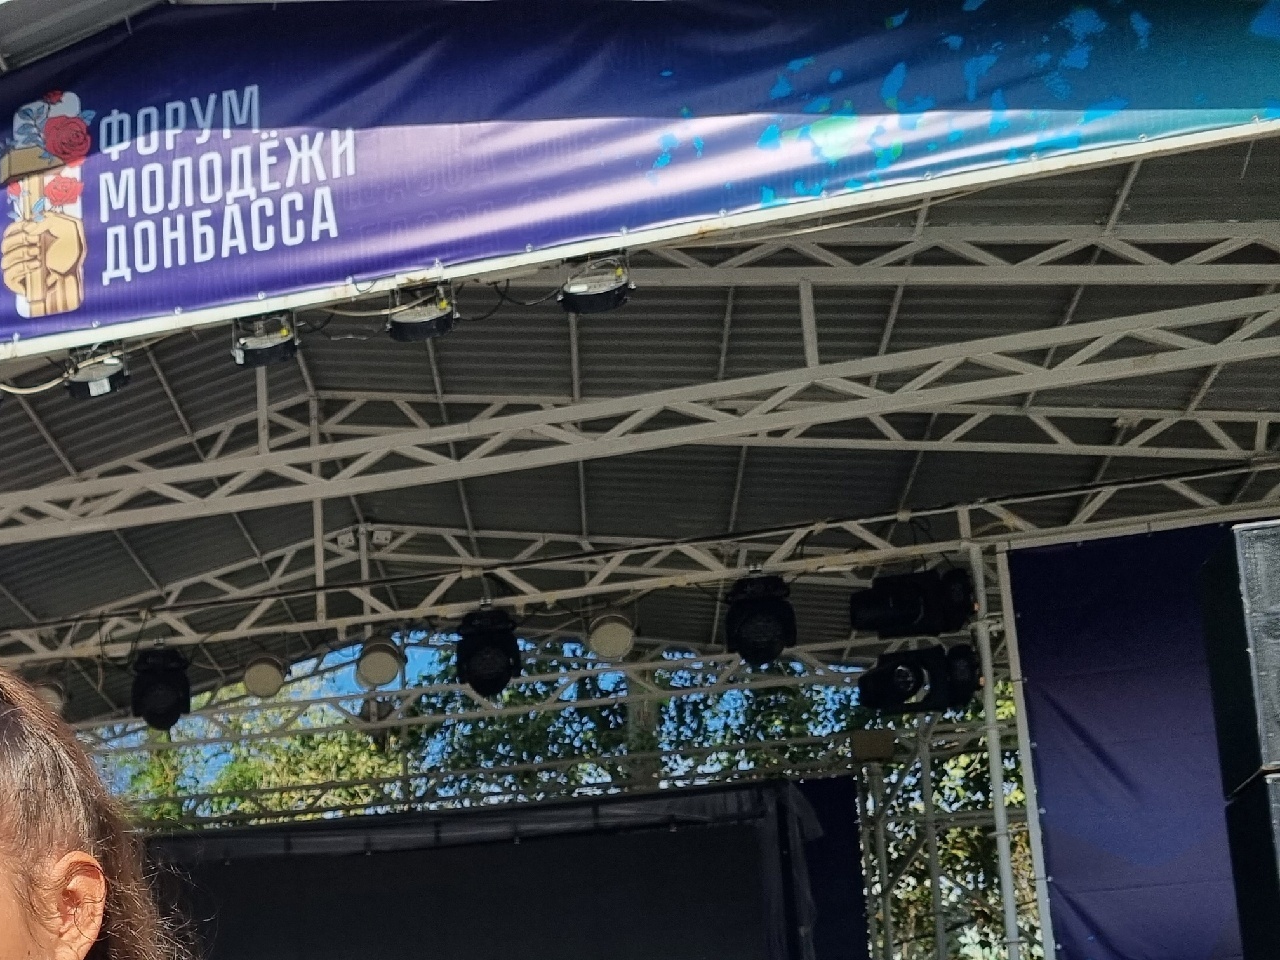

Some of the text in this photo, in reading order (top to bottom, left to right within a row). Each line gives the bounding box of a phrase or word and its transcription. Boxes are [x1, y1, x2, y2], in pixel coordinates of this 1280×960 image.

[99, 84, 261, 162] ФОРУМ
[99, 128, 357, 223] МОЛОДЁЖИ
[101, 186, 339, 286] ДОНБАССА
